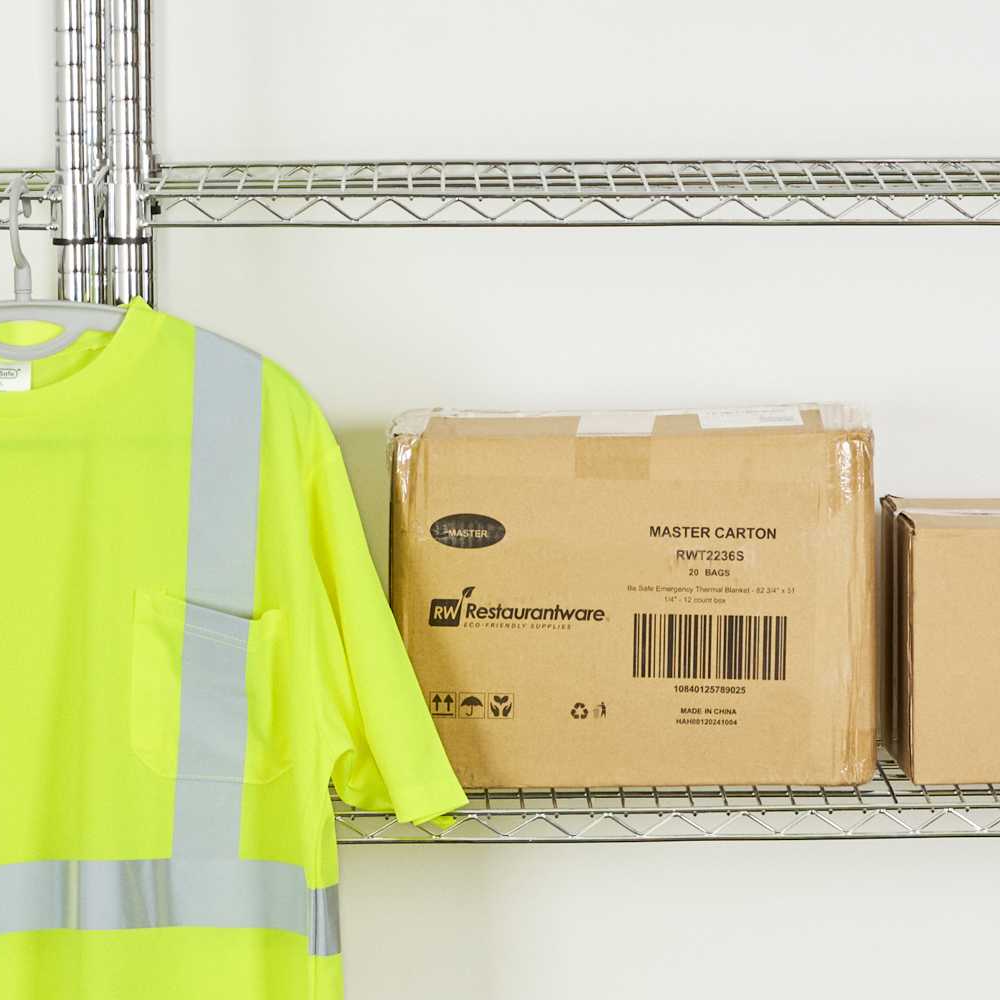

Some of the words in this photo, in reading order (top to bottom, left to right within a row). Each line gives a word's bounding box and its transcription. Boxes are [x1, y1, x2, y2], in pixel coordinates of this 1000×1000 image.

[448, 528, 488, 538] MASTER
[649, 525, 710, 539] MASTER
[714, 527, 777, 540] CARTON
[676, 549, 744, 562] RWT2236S
[688, 568, 699, 577] 20
[704, 569, 730, 577] BAGS
[655, 585, 693, 595] Emergency
[696, 585, 723, 593] Thermal
[724, 586, 750, 594] Blanket
[433, 605, 459, 620] RW
[465, 603, 606, 622] Restaurantware
[680, 707, 701, 715] MADE
